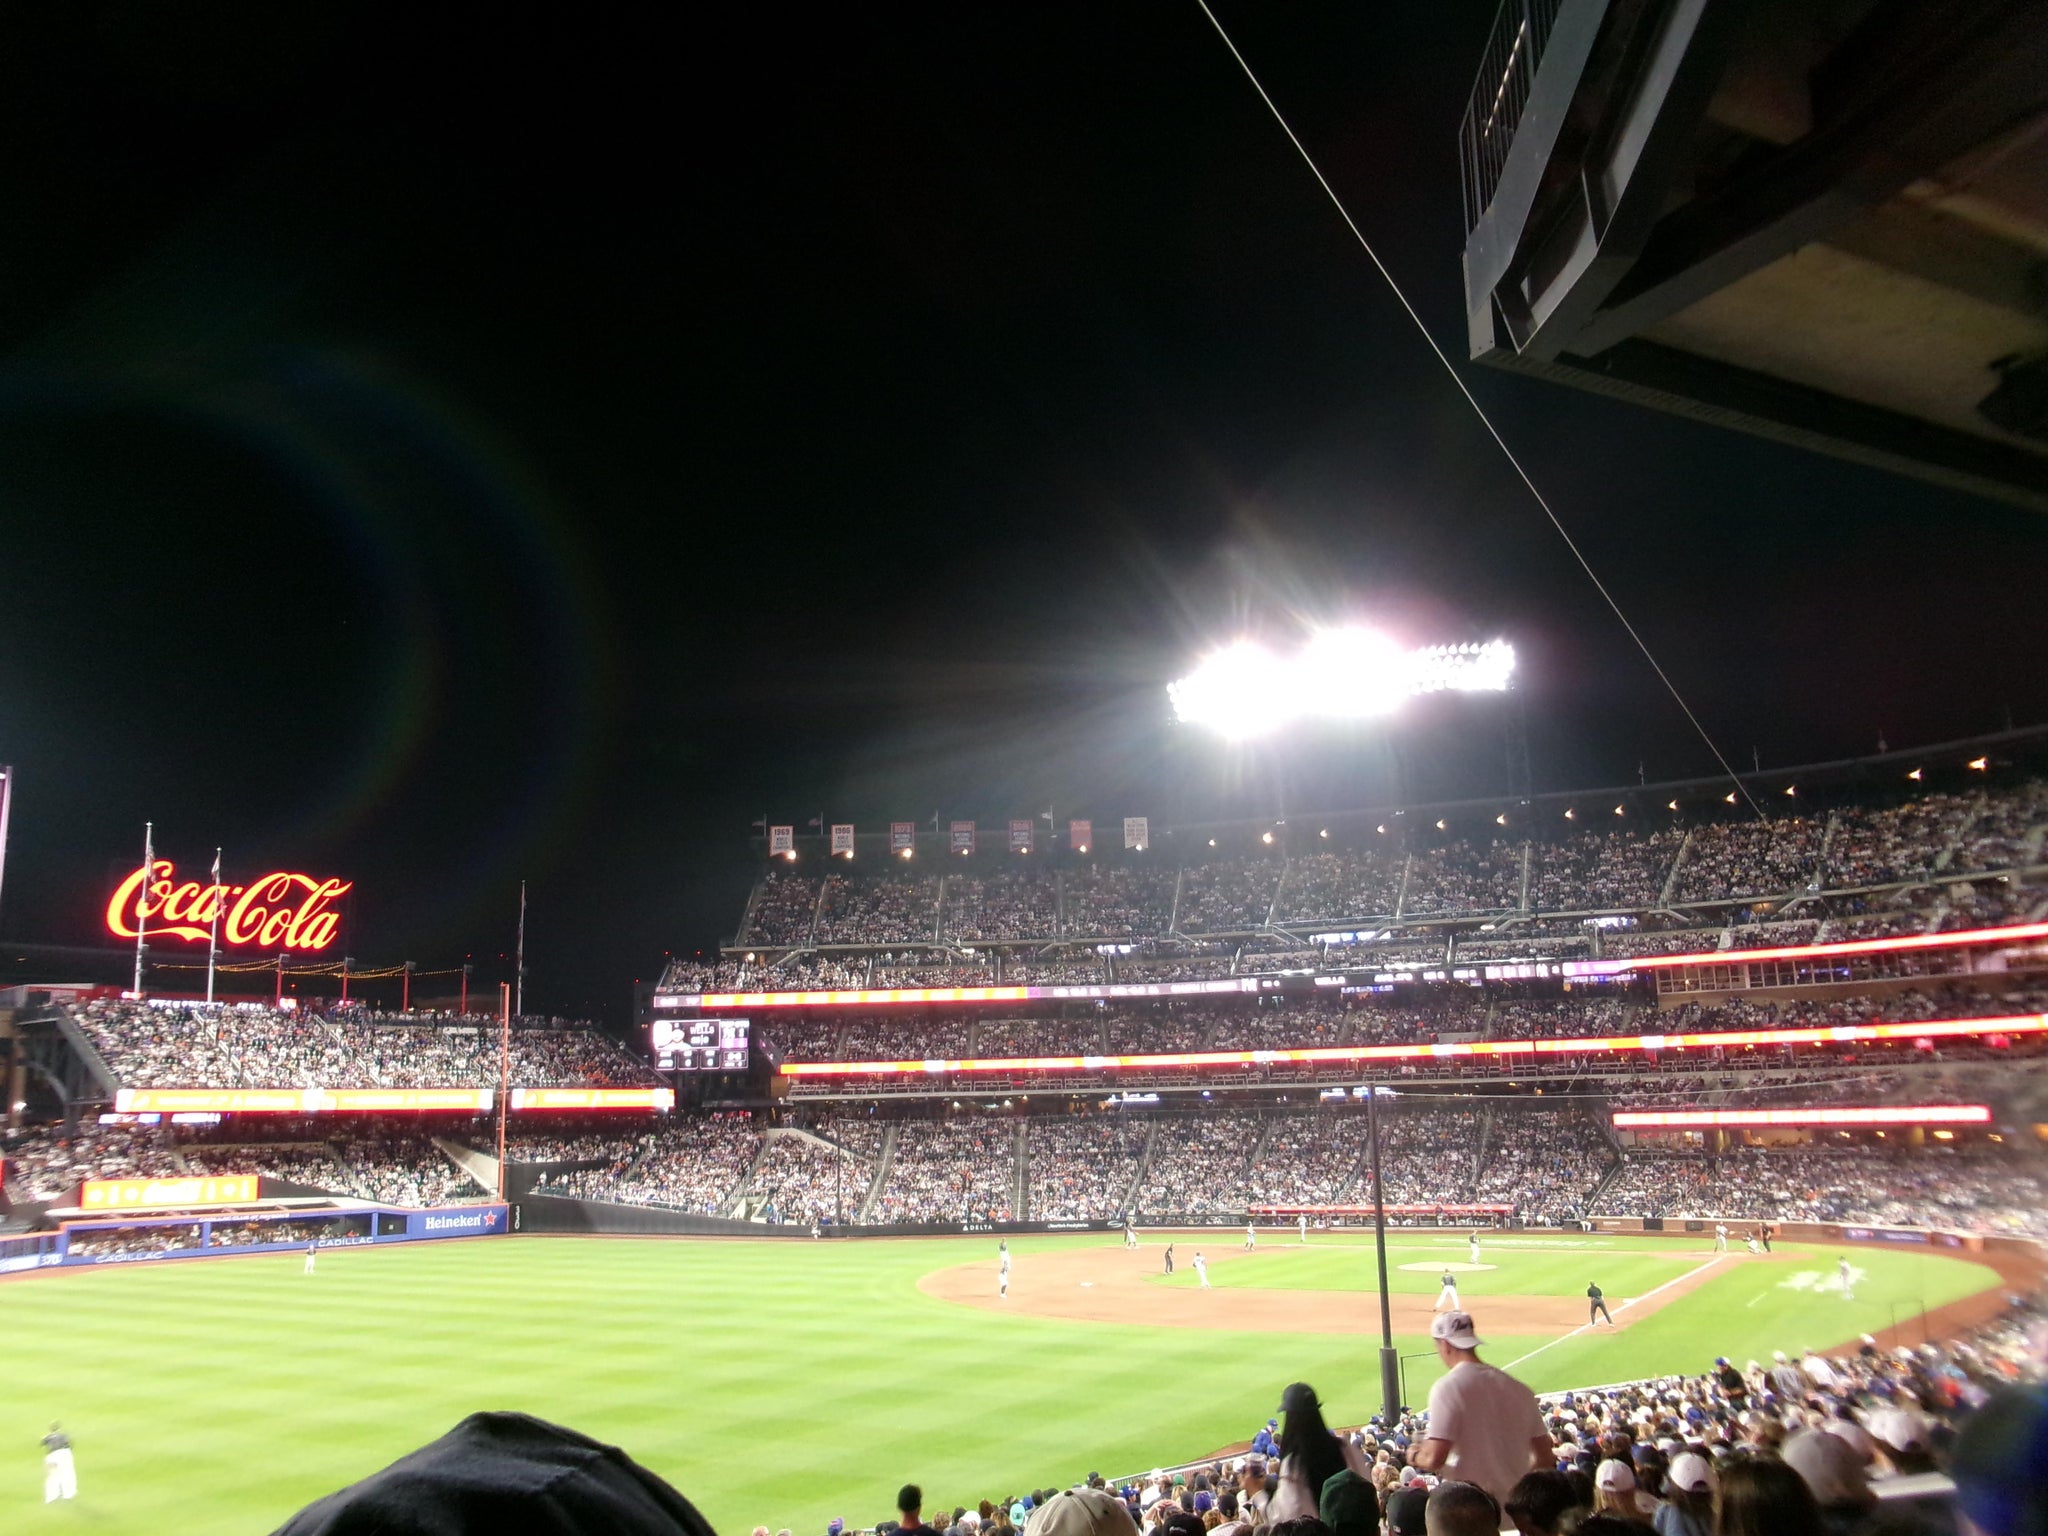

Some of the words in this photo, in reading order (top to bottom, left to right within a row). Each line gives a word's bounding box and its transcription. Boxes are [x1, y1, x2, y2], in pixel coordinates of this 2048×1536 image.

[774, 828, 790, 836] 1969
[690, 1026, 715, 1035] WELLS
[425, 1213, 482, 1230] Heineken
[318, 1236, 374, 1248] CADILLAC
[95, 1251, 165, 1264] CADILLAC
